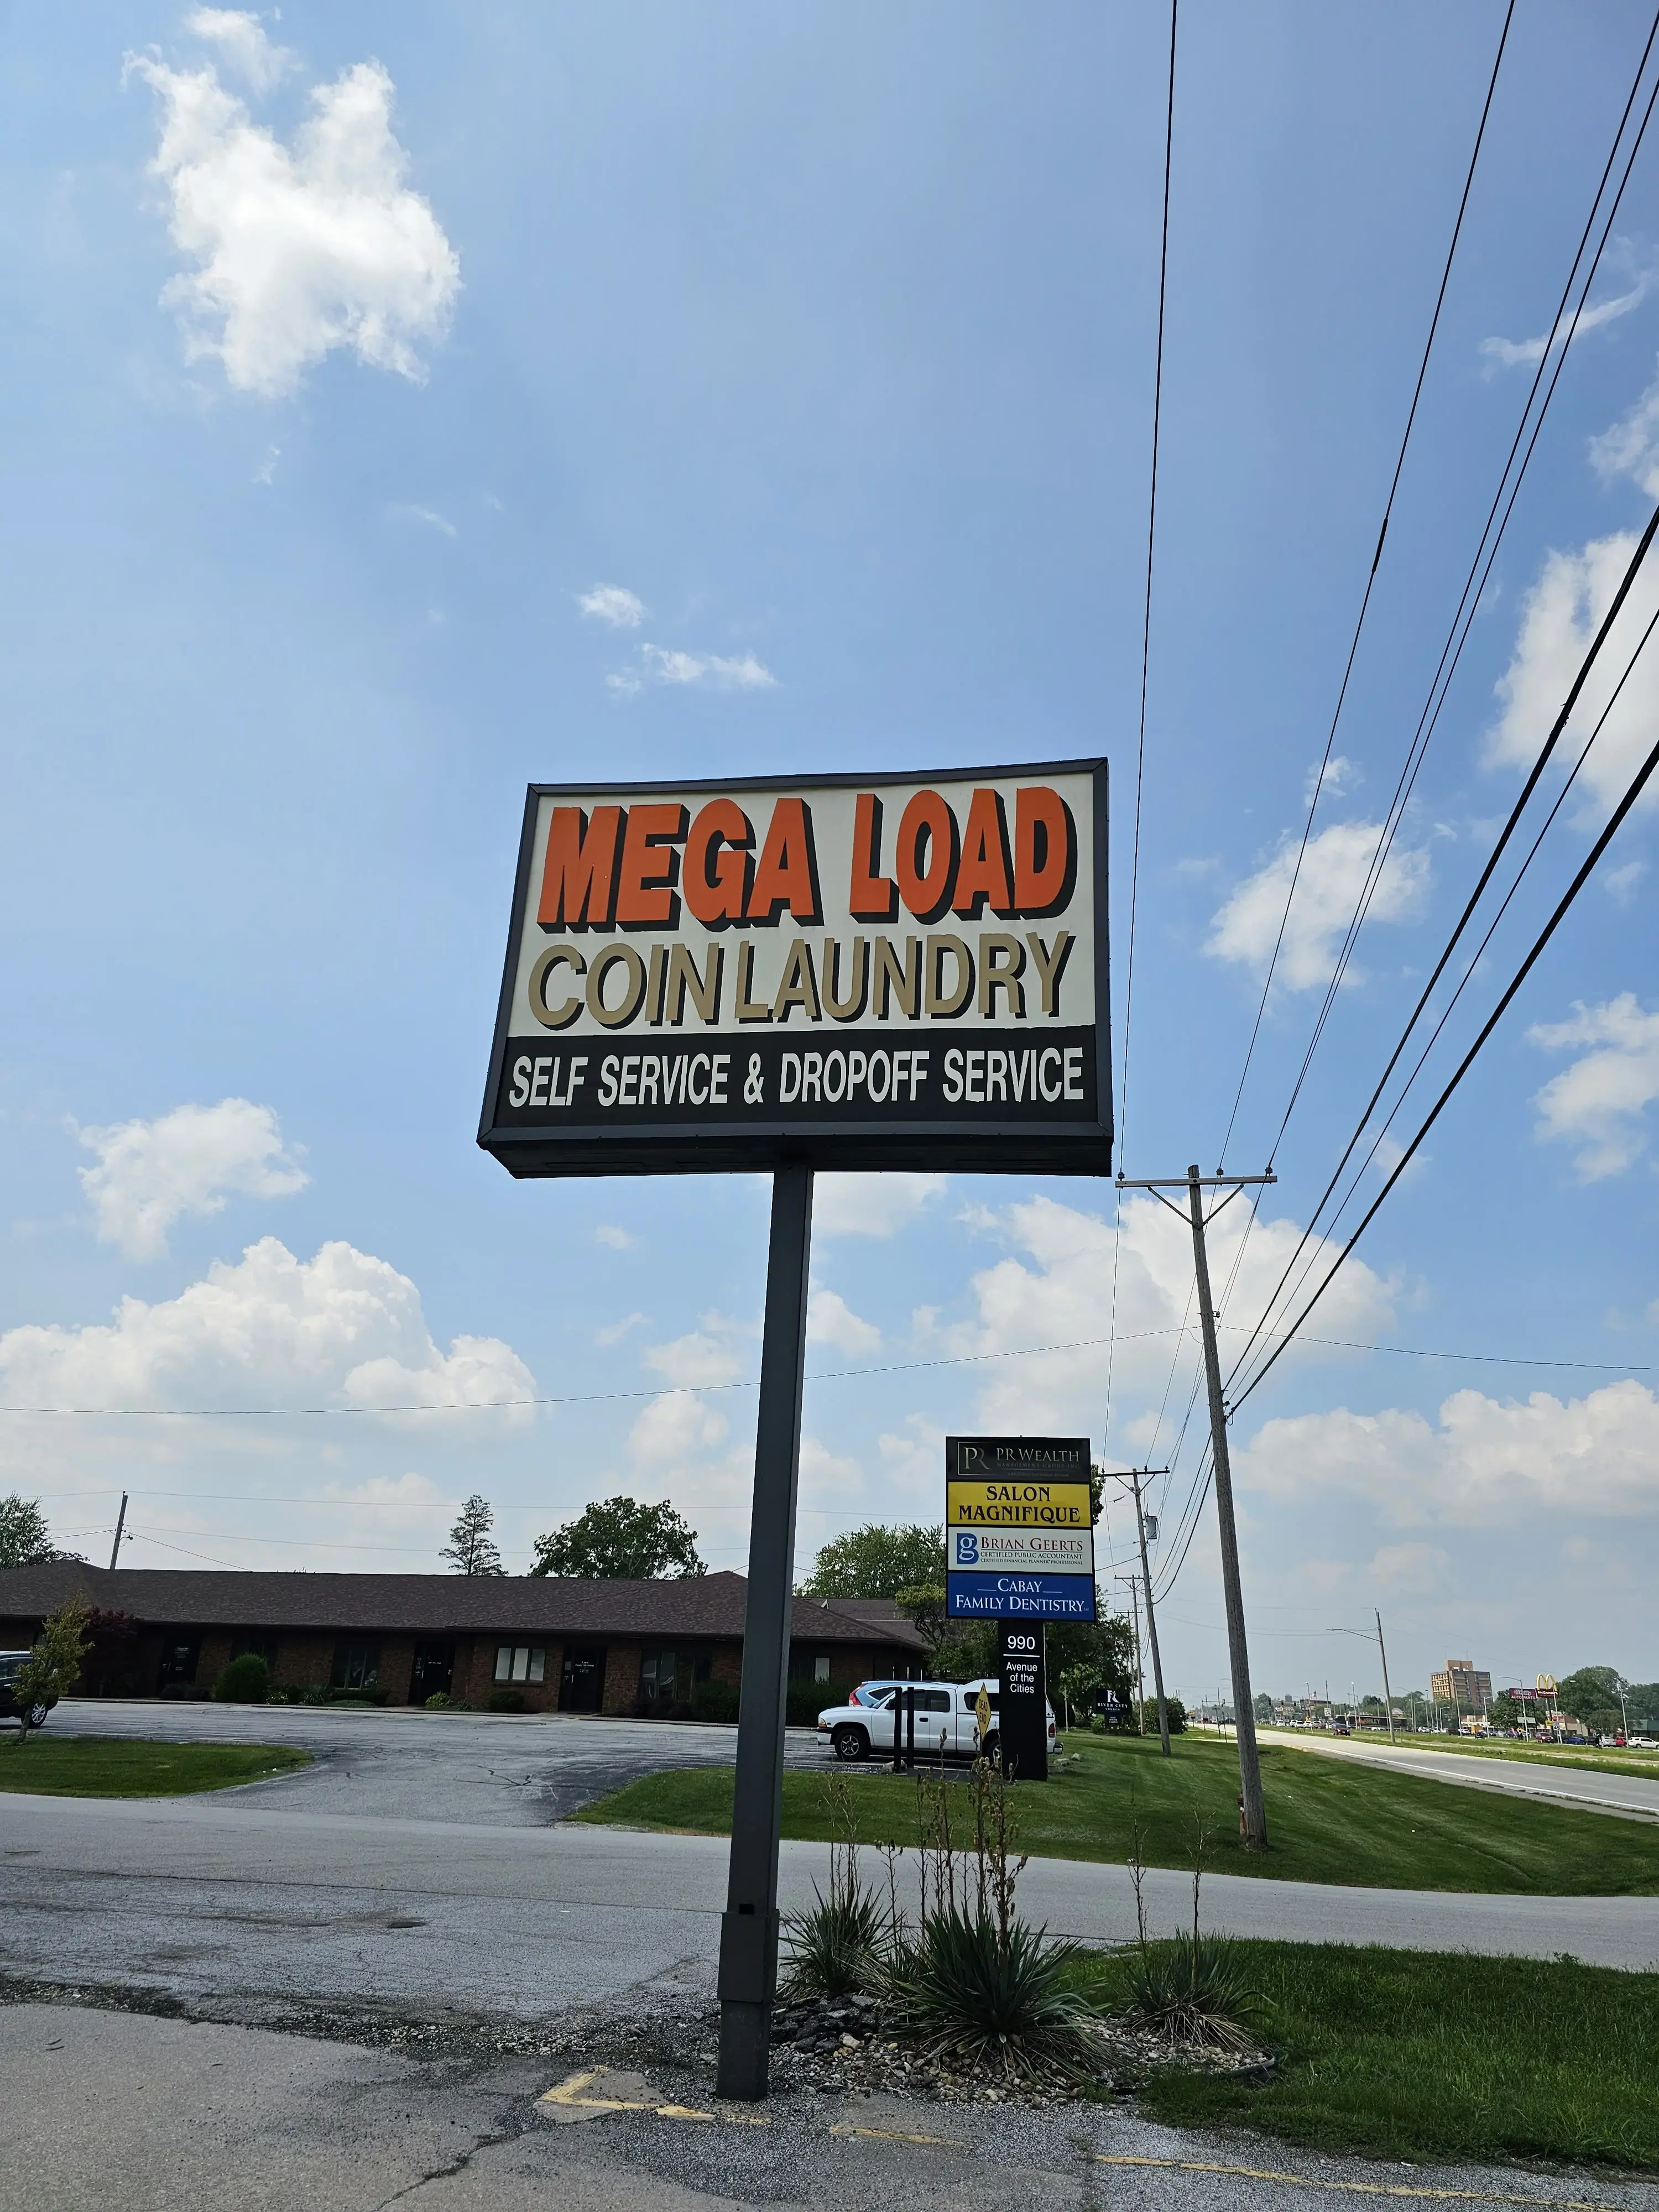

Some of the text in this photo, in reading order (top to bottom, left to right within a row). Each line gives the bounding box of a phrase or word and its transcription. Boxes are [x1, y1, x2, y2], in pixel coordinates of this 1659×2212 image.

[536, 786, 1078, 934] MEGA LOAD
[528, 930, 1077, 1031] COIN LAUNDRY
[509, 1047, 1084, 1107] SELF SERVICE & DROPOFF SERVICE
[996, 1448, 1079, 1462] PR WEALTH
[986, 1486, 1051, 1502] SALON
[958, 1505, 1081, 1524] MAGNIFIQUE
[981, 1536, 1083, 1551] BRIAN GEERTS
[997, 1578, 1042, 1593] CABAY
[956, 1594, 1004, 1609] FAMILY
[1009, 1596, 1084, 1612] DENTISTRY
[1008, 1635, 1035, 1650] 990
[1006, 1661, 1037, 1672] Avenue
[1010, 1673, 1034, 1682] of the
[1010, 1683, 1035, 1693] Cities
[979, 1698, 988, 1712] DEAD
